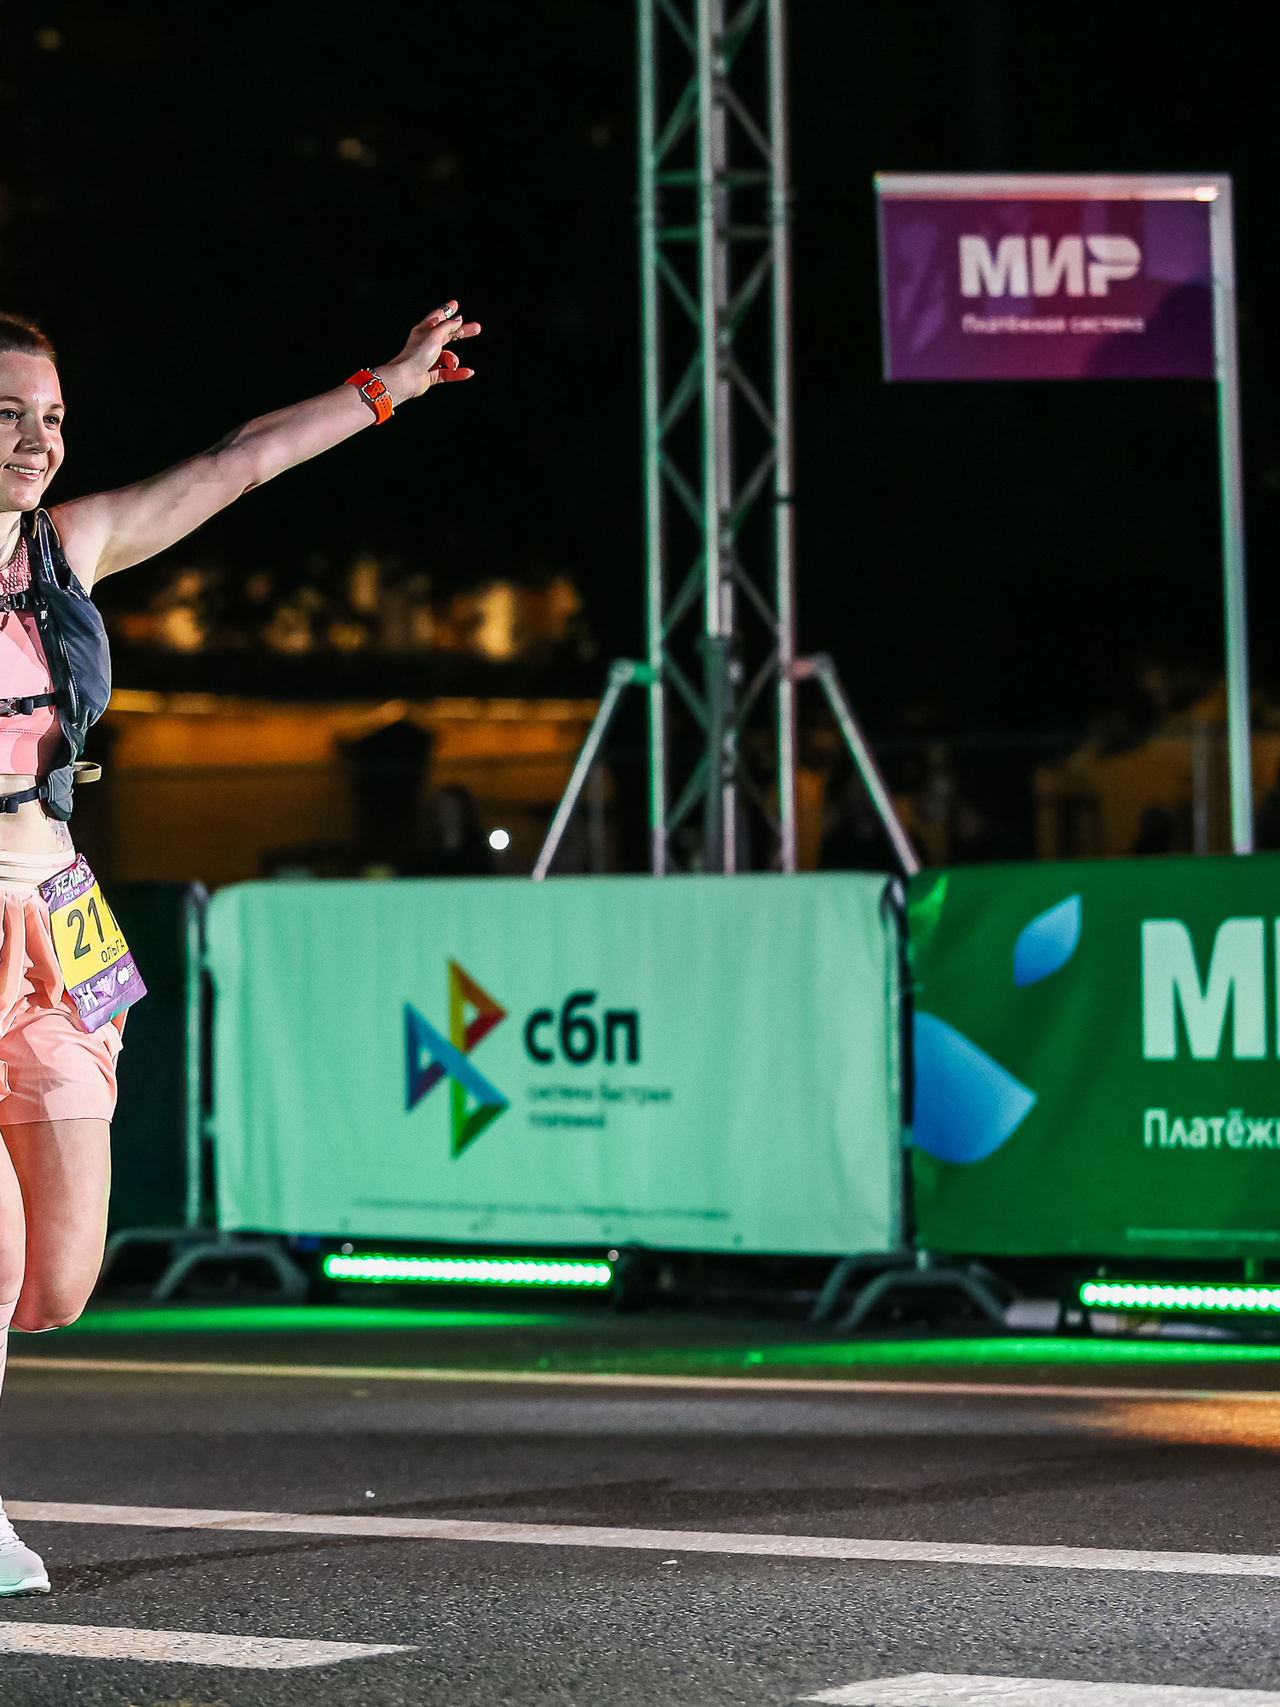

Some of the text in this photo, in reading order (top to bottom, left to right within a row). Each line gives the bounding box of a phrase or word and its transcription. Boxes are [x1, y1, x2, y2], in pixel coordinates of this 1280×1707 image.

[959, 234, 1141, 298] МИР
[1141, 916, 1280, 1061] М
[1144, 1107, 1280, 1149] Платёж
